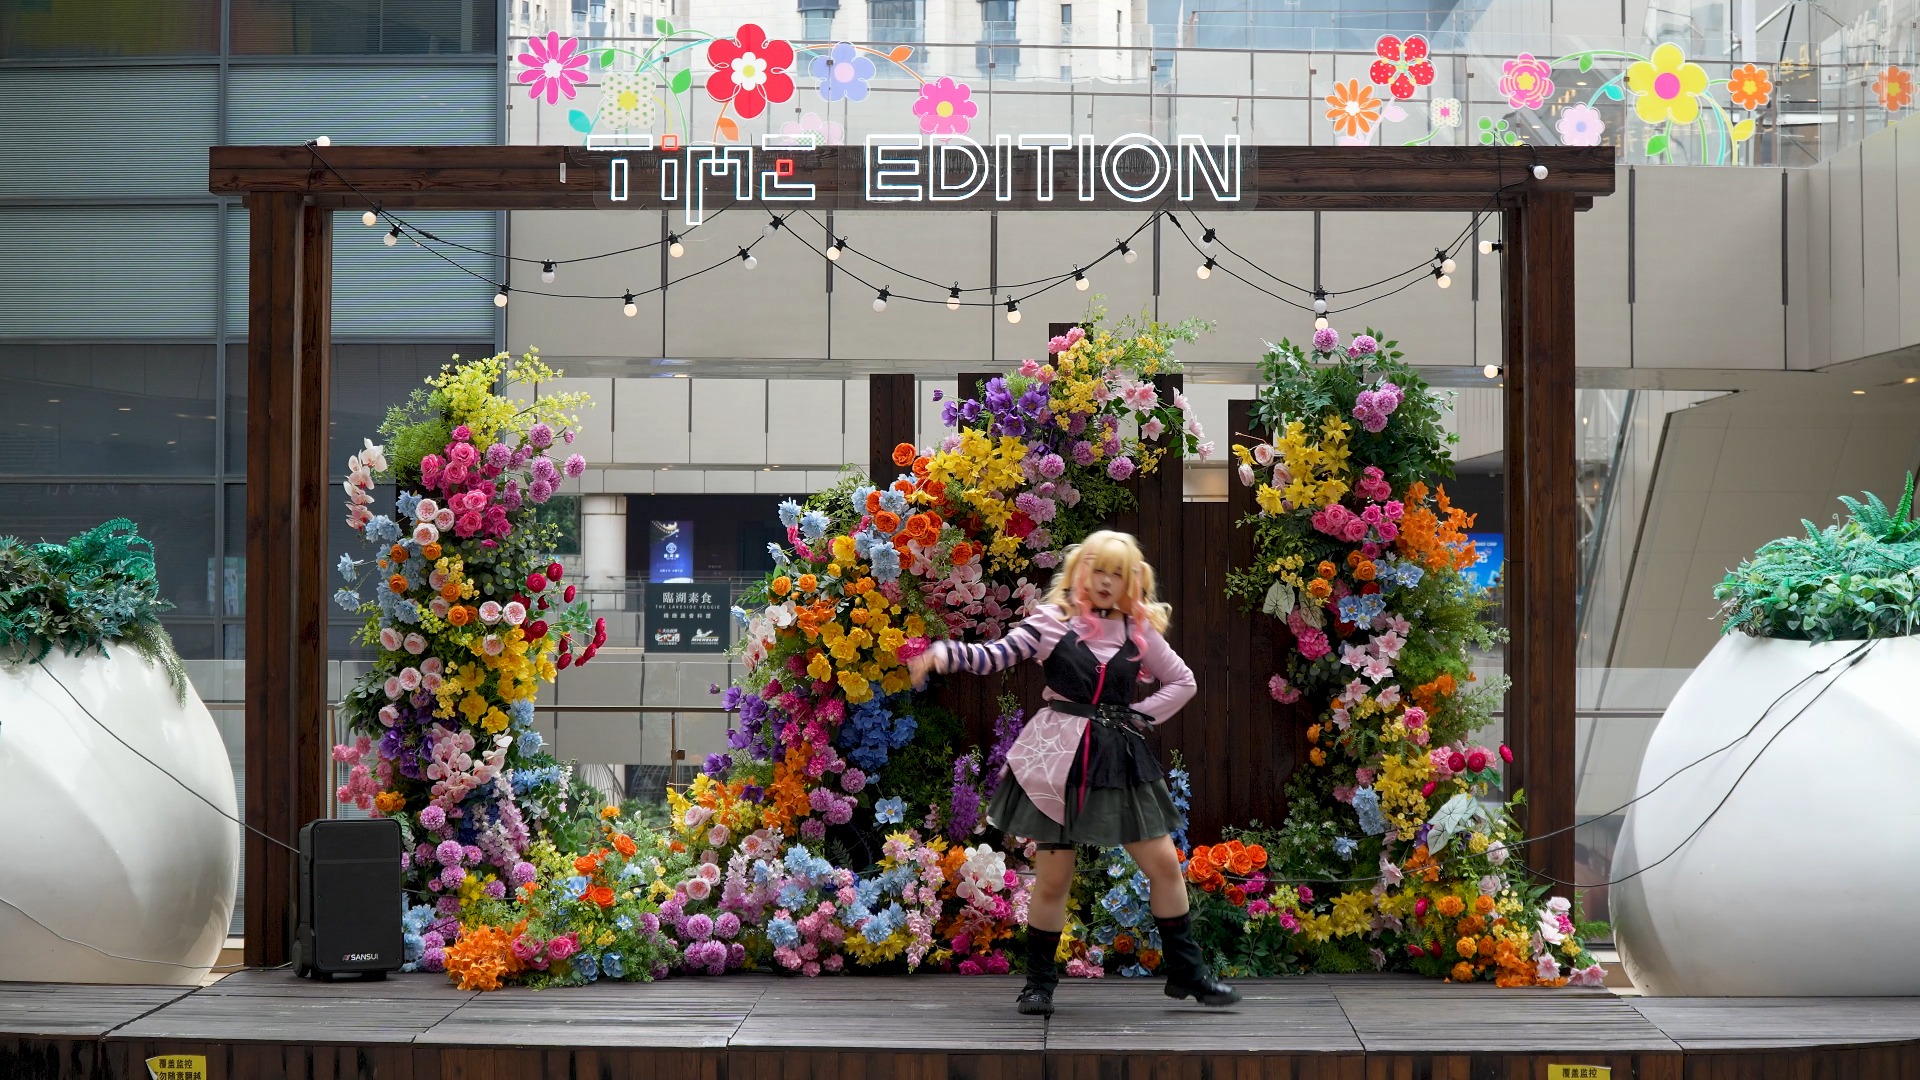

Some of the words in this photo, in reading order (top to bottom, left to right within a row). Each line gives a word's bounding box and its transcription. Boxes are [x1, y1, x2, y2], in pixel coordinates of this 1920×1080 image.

[864, 132, 1242, 202] EDITION
[662, 592, 712, 604] 臨湖素食
[350, 953, 379, 961] SANSUI
[158, 1058, 193, 1069] 覆盖监控
[1562, 1068, 1598, 1079] 覆盖监控
